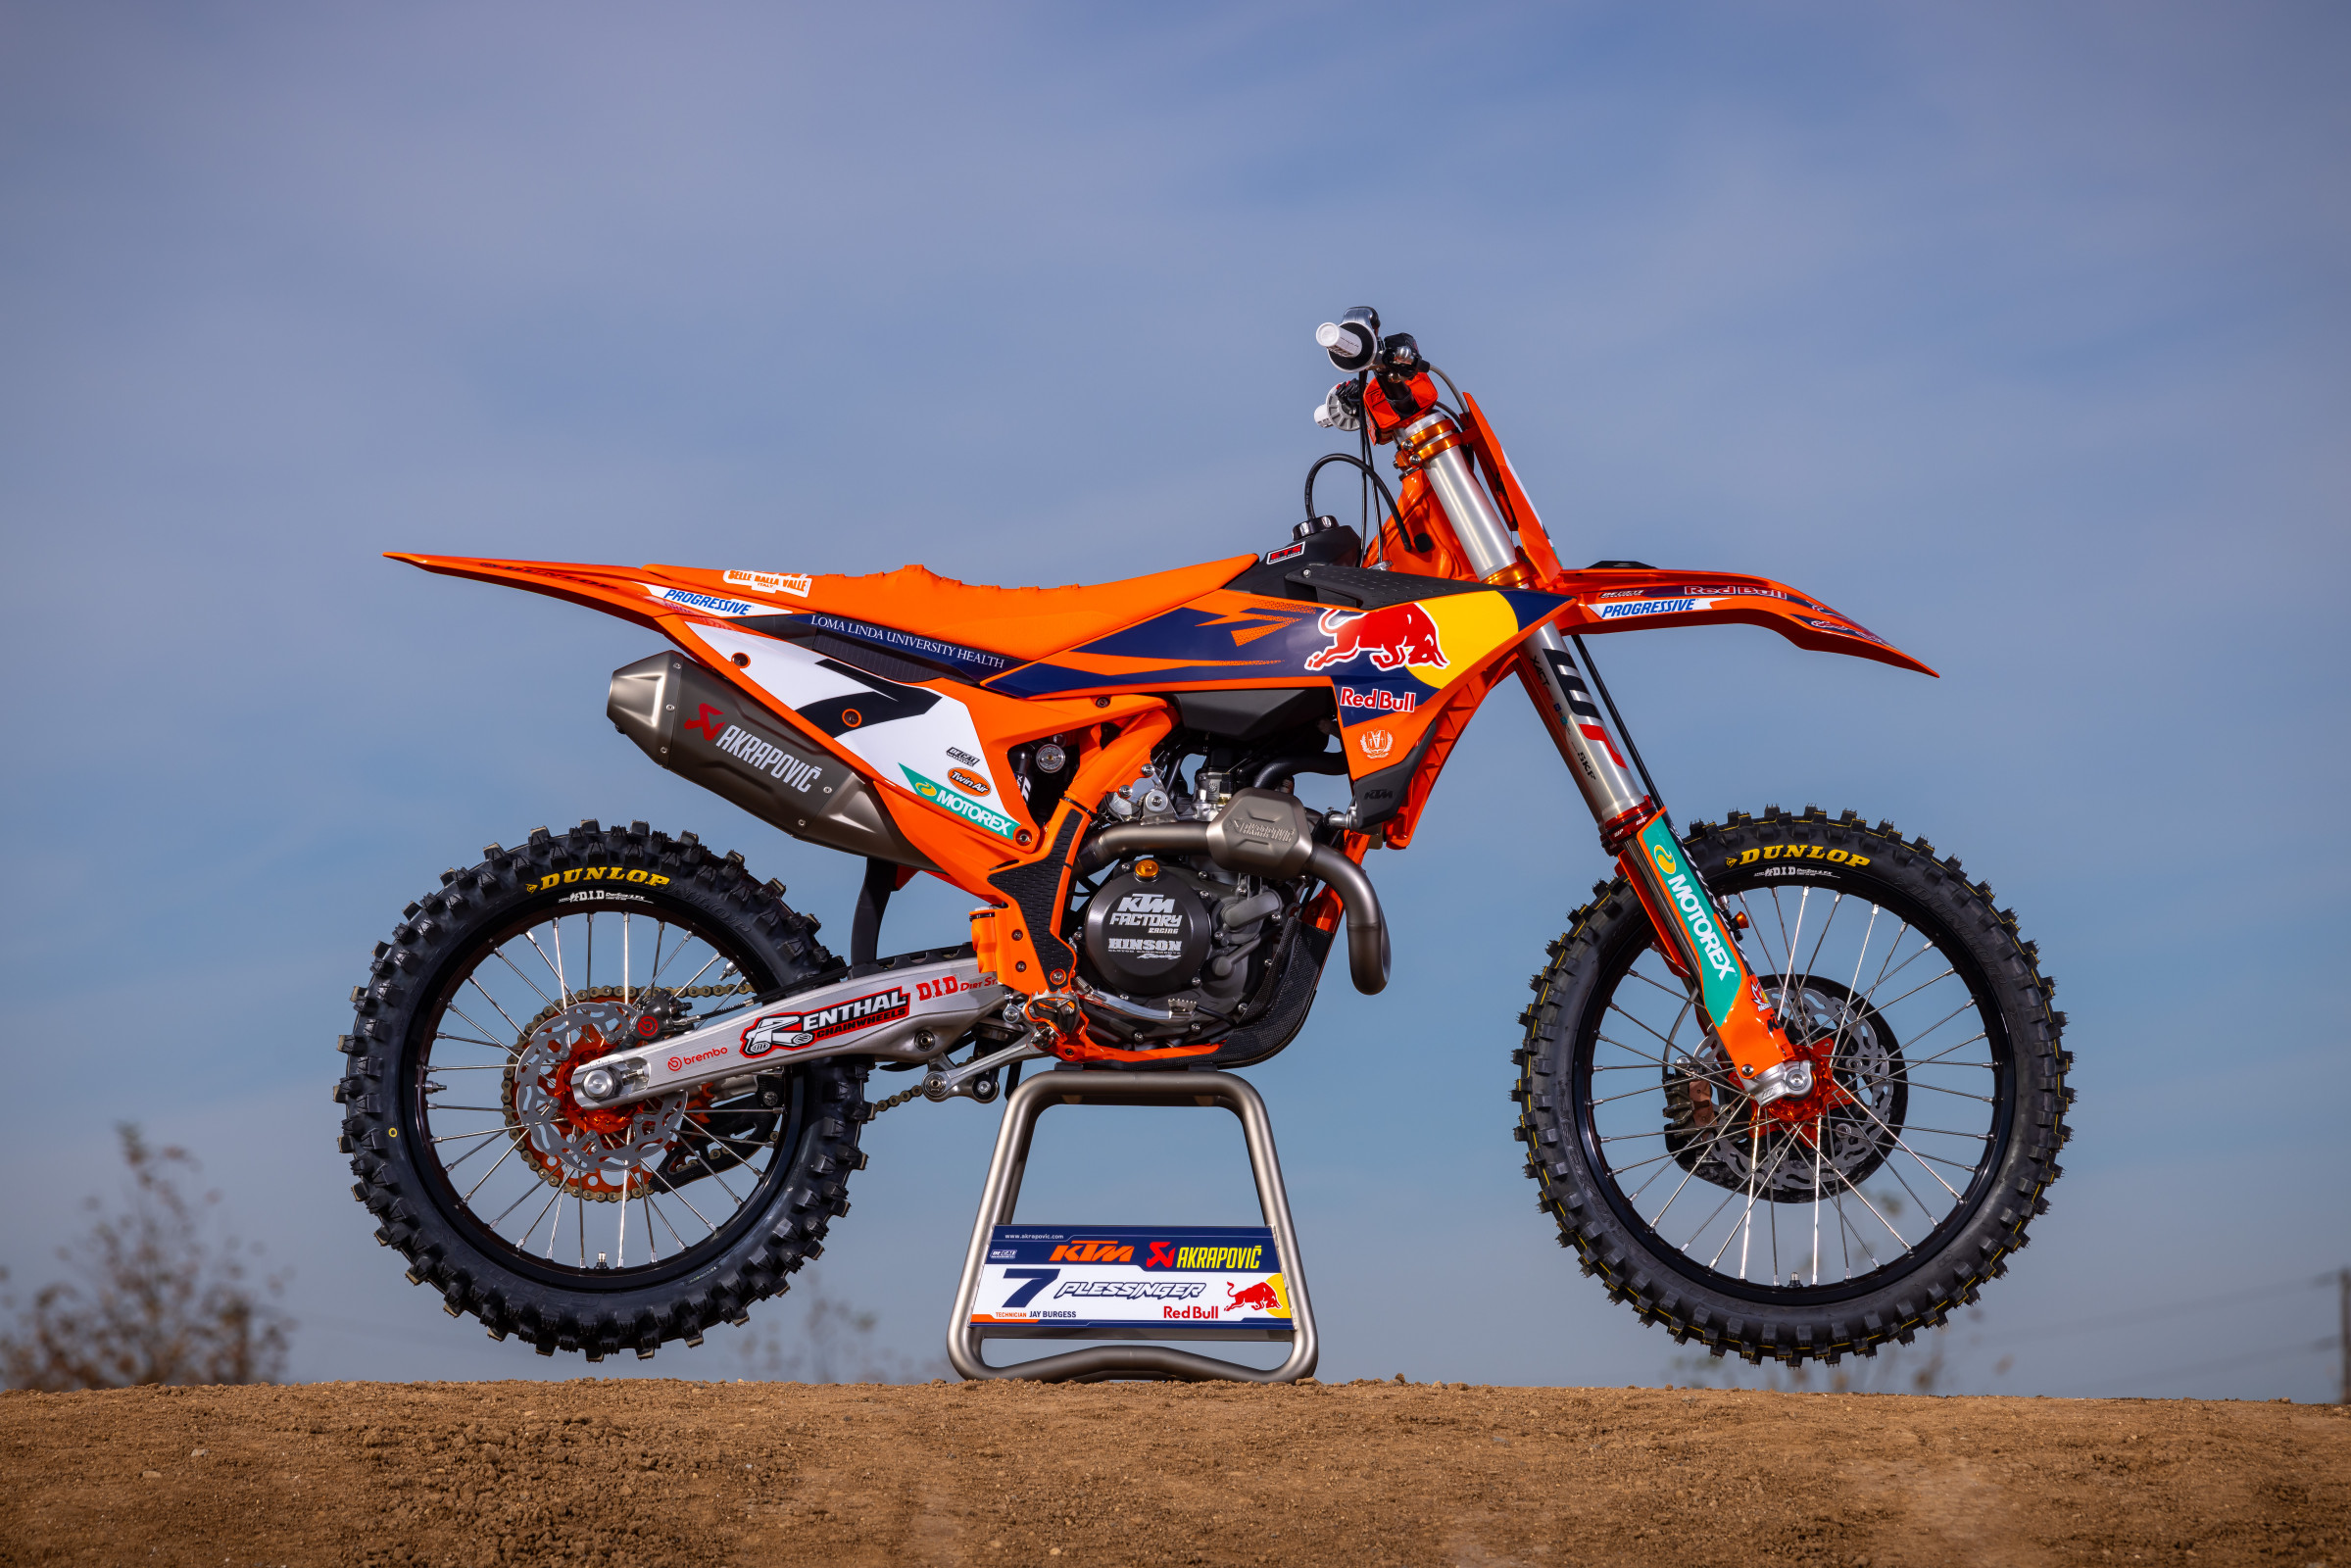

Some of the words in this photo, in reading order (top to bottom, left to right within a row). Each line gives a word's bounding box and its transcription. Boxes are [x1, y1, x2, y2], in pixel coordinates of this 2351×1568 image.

[663, 589, 753, 616] PROGRESSIVE
[1685, 586, 1736, 595] Red
[1738, 586, 1787, 601] Bull
[1601, 598, 1695, 618] PROGRESSIVE
[810, 614, 846, 632] LOMA
[848, 623, 884, 640] LINDA
[887, 631, 956, 658] UNIVERSITY
[956, 649, 1005, 669] HEALTH
[1530, 655, 1550, 686] XACT
[1340, 687, 1378, 709] Red
[1378, 692, 1416, 713] Bull
[1578, 751, 1596, 781] SKF
[951, 770, 973, 788] Twin
[971, 782, 989, 795] Air
[1364, 789, 1394, 800] KTM
[936, 790, 1011, 836] MOTOREX
[1739, 845, 1871, 866] DUNLOP
[540, 866, 670, 891] DUNLOP
[1117, 893, 1175, 913] KTM
[1109, 912, 1183, 927] FACTORY
[1667, 873, 1737, 981] MOTOREX
[1108, 938, 1183, 952] HINSON
[984, 976, 998, 987] ST
[816, 1007, 906, 1038] CHAINWHEELS
[684, 1047, 728, 1065] brembo
[1050, 1240, 1135, 1262] KTM
[1002, 1268, 1061, 1308] 7
[1053, 1281, 1206, 1299] PLESSINGER
[1163, 1305, 1190, 1319] Red
[1192, 1306, 1218, 1319] Bull
